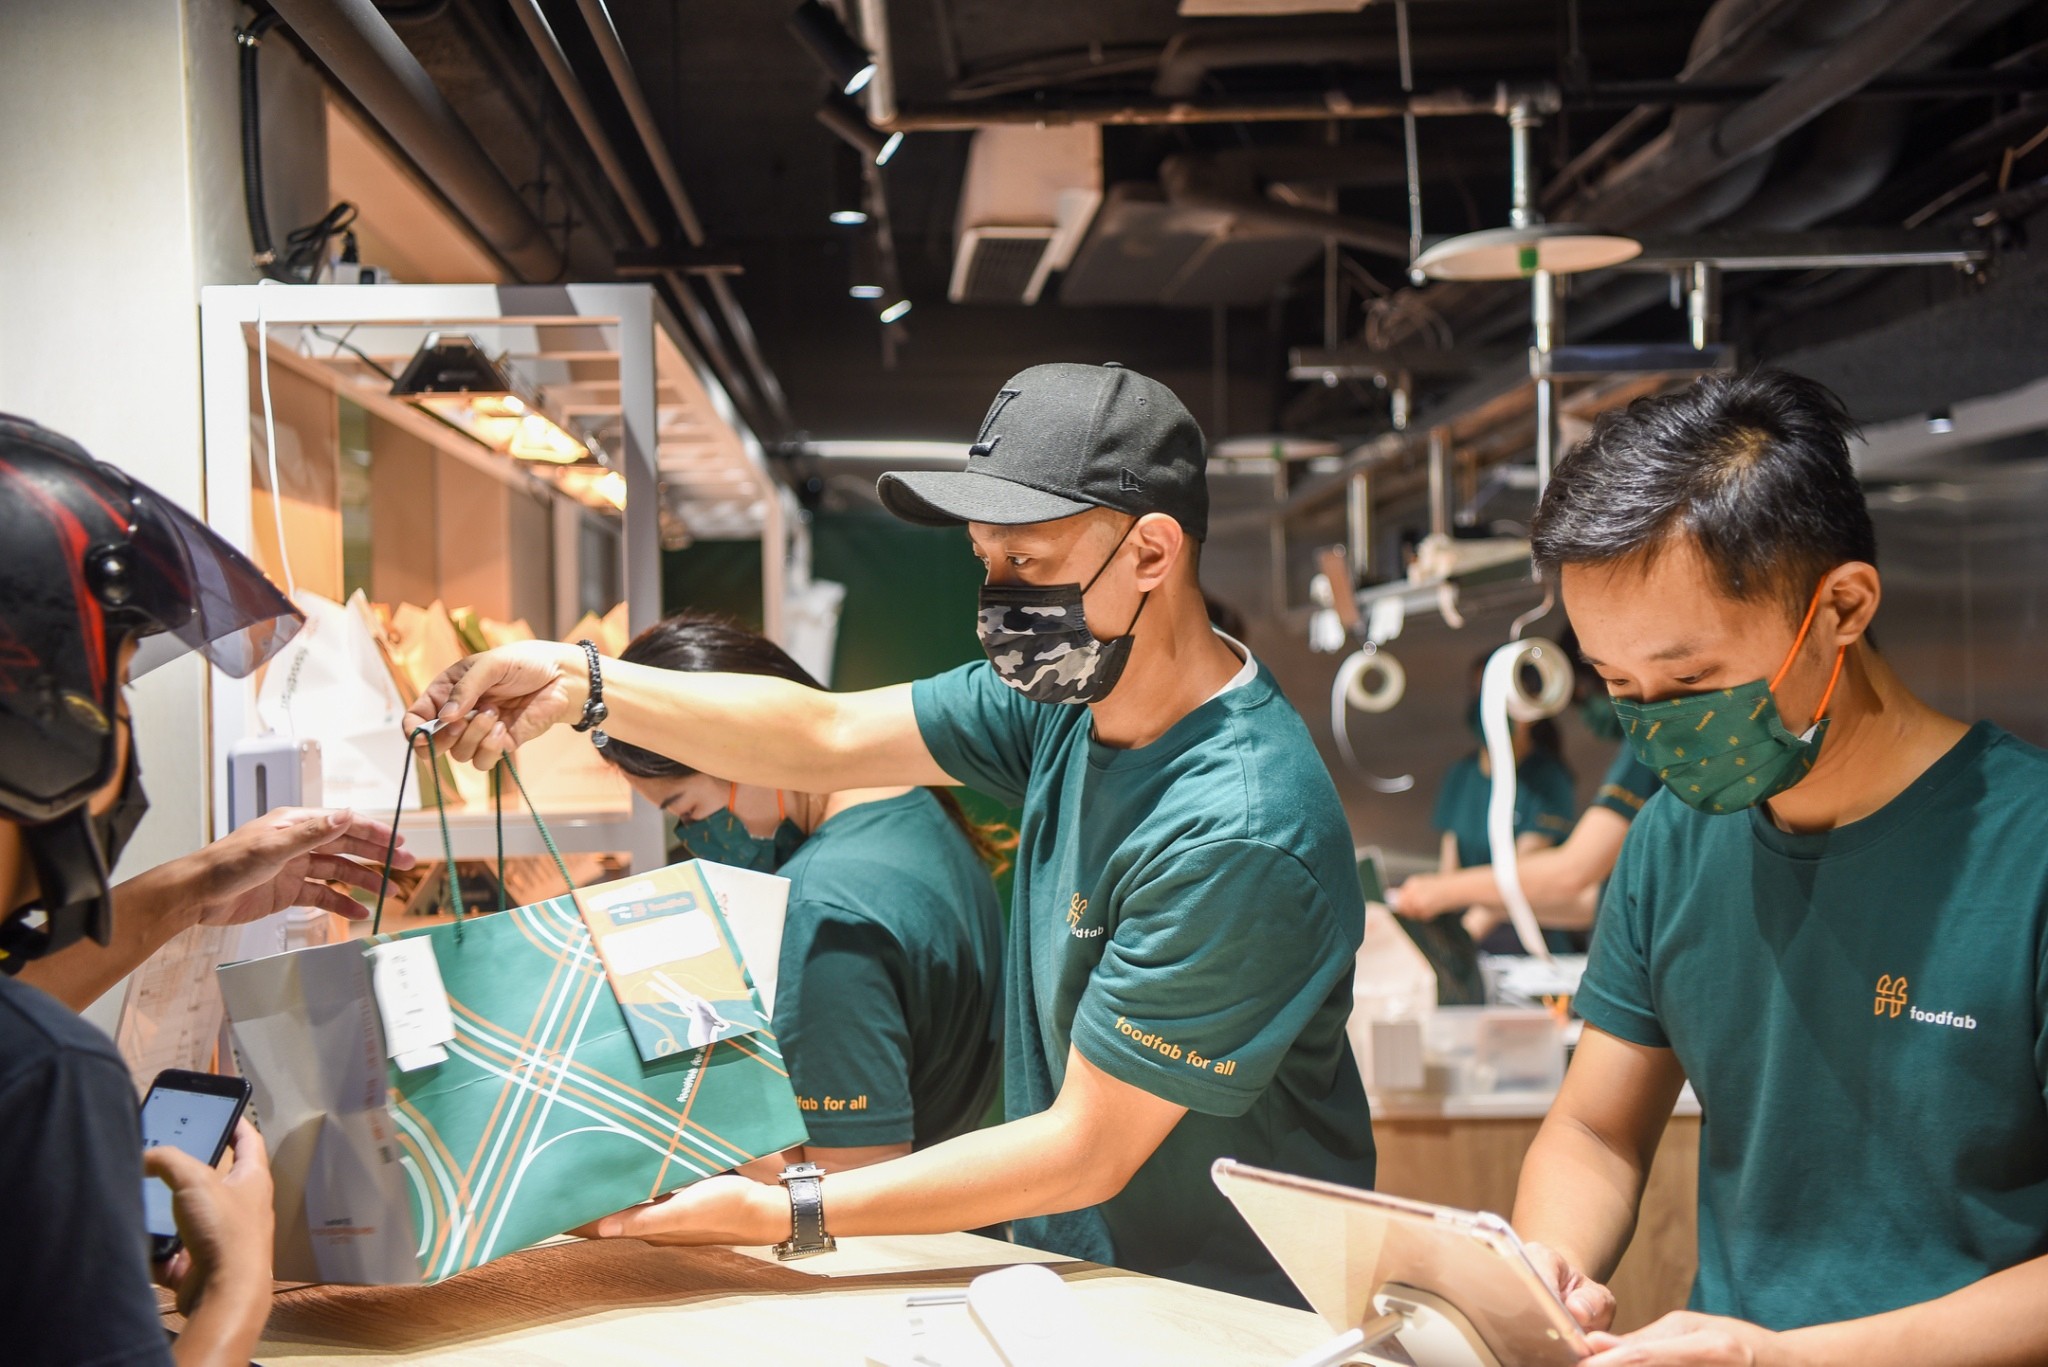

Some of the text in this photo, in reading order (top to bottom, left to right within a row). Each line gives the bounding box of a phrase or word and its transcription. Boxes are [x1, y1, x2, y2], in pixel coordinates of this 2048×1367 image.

[1909, 1006, 1978, 1030] foodfab
[1114, 1016, 1237, 1076] foodfab for all
[823, 1095, 847, 1111] for
[848, 1094, 867, 1111] all
